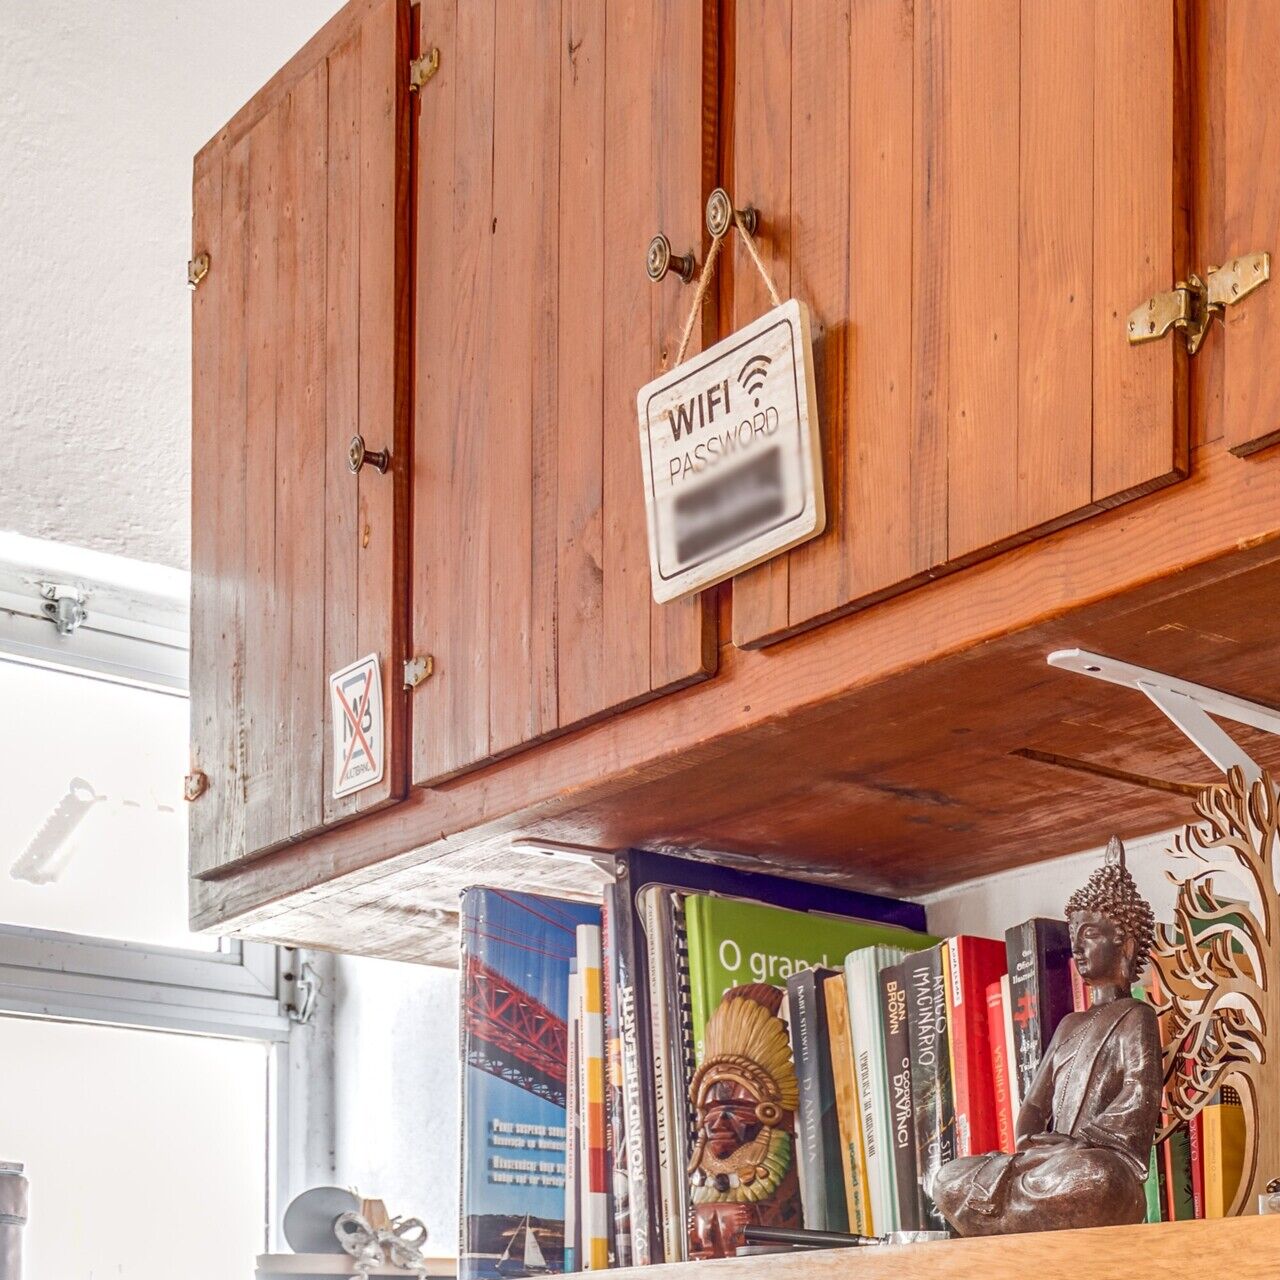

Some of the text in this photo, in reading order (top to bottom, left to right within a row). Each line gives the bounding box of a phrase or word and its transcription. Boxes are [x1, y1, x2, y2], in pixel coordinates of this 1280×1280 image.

[668, 379, 731, 442] WIFI
[669, 406, 779, 486] PASSWORD
[719, 939, 741, 971] O
[797, 985, 806, 1015] ISABEL
[886, 981, 899, 1035] BROWN
[896, 990, 906, 1022] DAN
[932, 974, 948, 1034] AMIGO
[622, 986, 647, 1181] ROUND THE EARTH
[653, 1056, 662, 1099] PELO
[901, 1057, 909, 1068] O
[993, 1045, 1007, 1102] CHINESA
[656, 1103, 666, 1154] CURA
[660, 1158, 668, 1170] A
[1191, 1151, 1199, 1161] O
